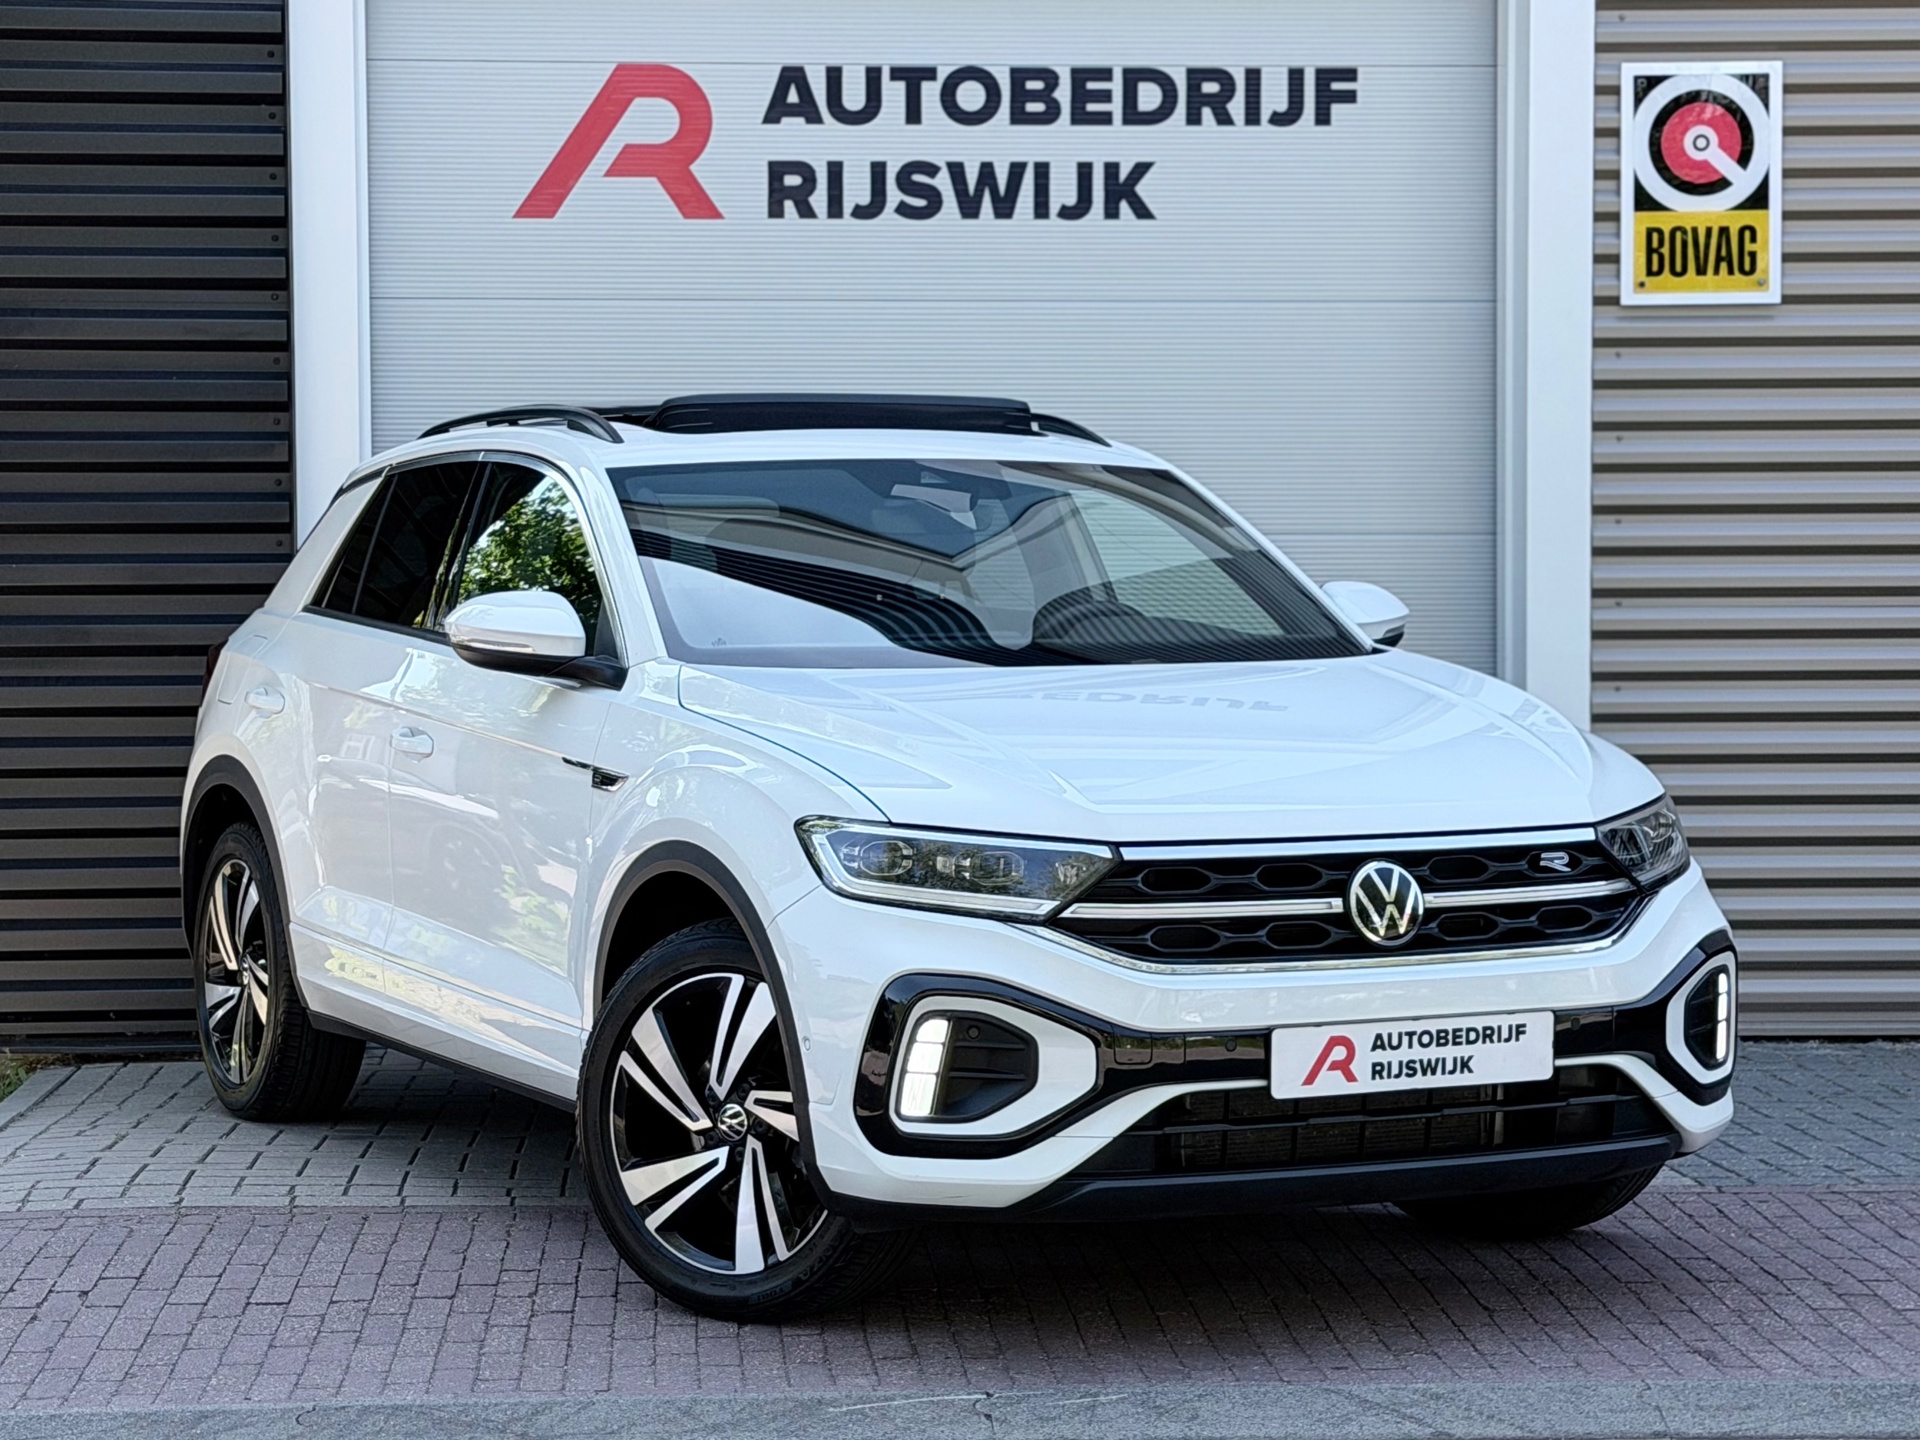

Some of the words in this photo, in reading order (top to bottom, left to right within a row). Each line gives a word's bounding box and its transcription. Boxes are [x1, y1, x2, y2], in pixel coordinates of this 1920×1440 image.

[761, 65, 1358, 127] AUTOBEDRIJF
[767, 160, 1157, 221] RIJSWIJK
[1645, 224, 1758, 278] BOVAG
[1350, 861, 1424, 946] VW
[1370, 1023, 1527, 1052] AUTOBEDRIJF
[1370, 1055, 1475, 1081] RIJSWIJK
